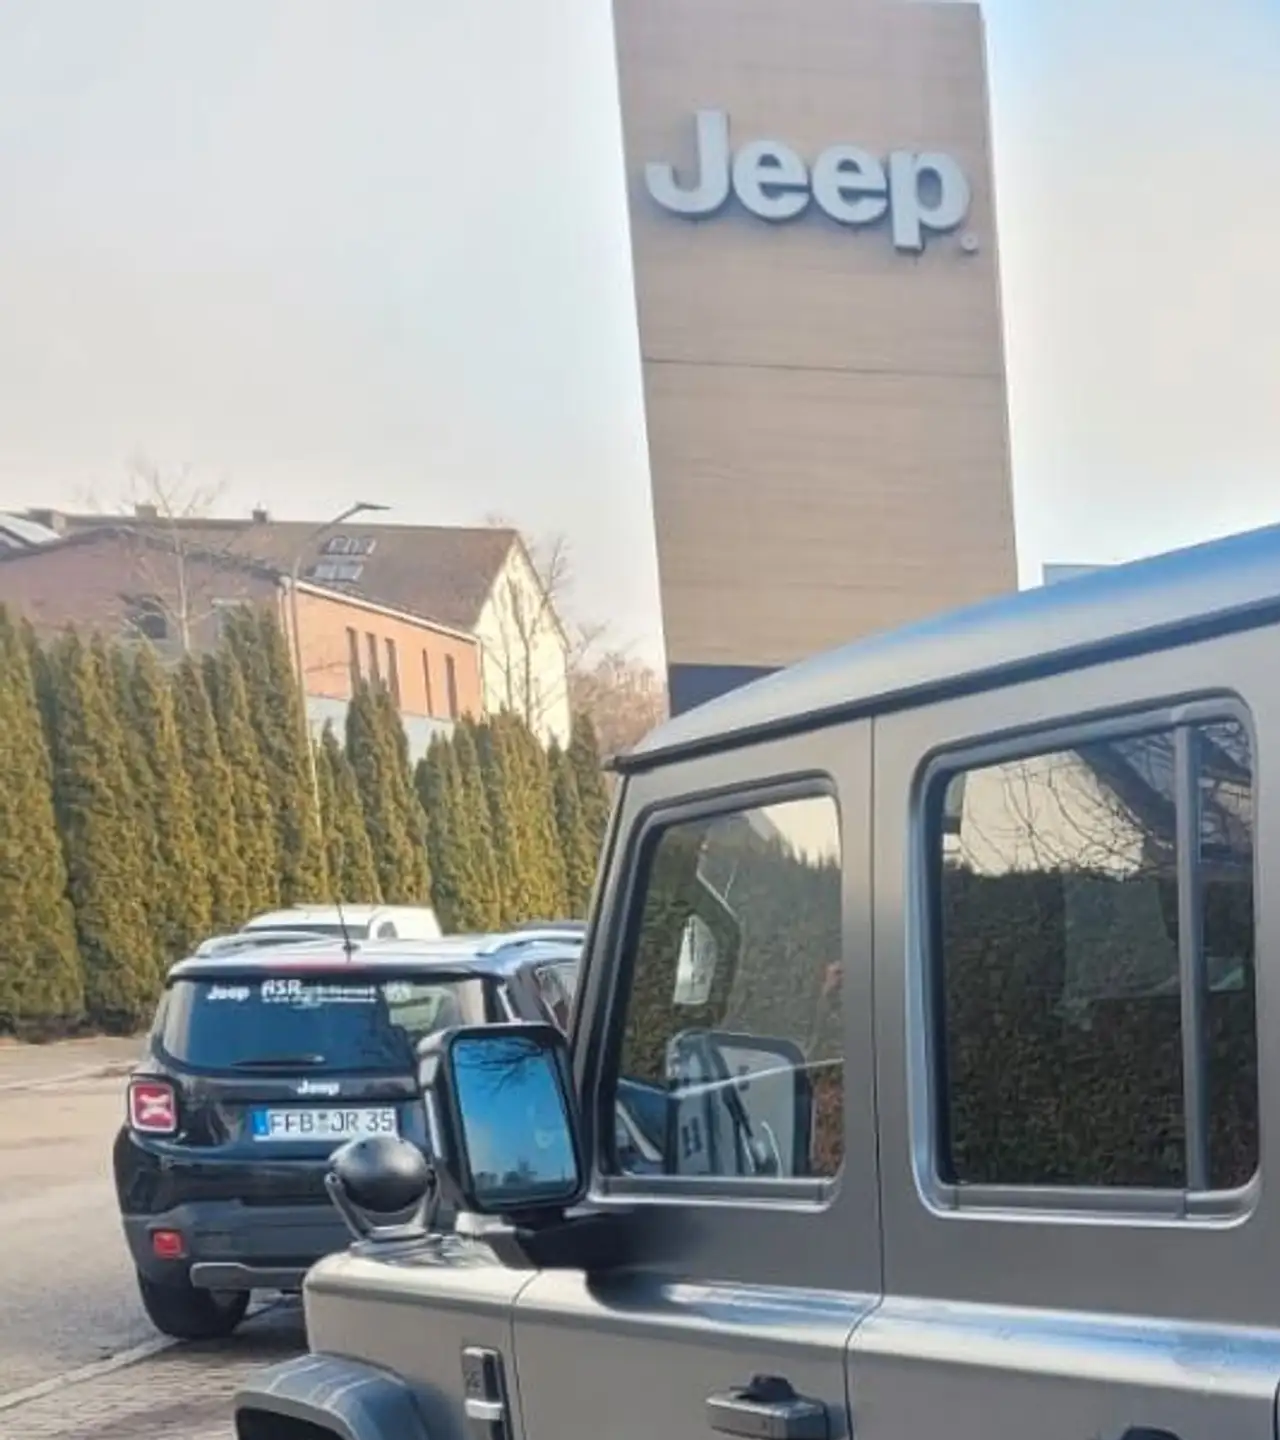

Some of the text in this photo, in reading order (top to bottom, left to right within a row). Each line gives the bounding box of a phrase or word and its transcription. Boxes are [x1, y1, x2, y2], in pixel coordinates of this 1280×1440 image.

[645, 110, 970, 250] Jeep
[262, 979, 301, 996] ASR
[298, 1079, 341, 1096] Jeep
